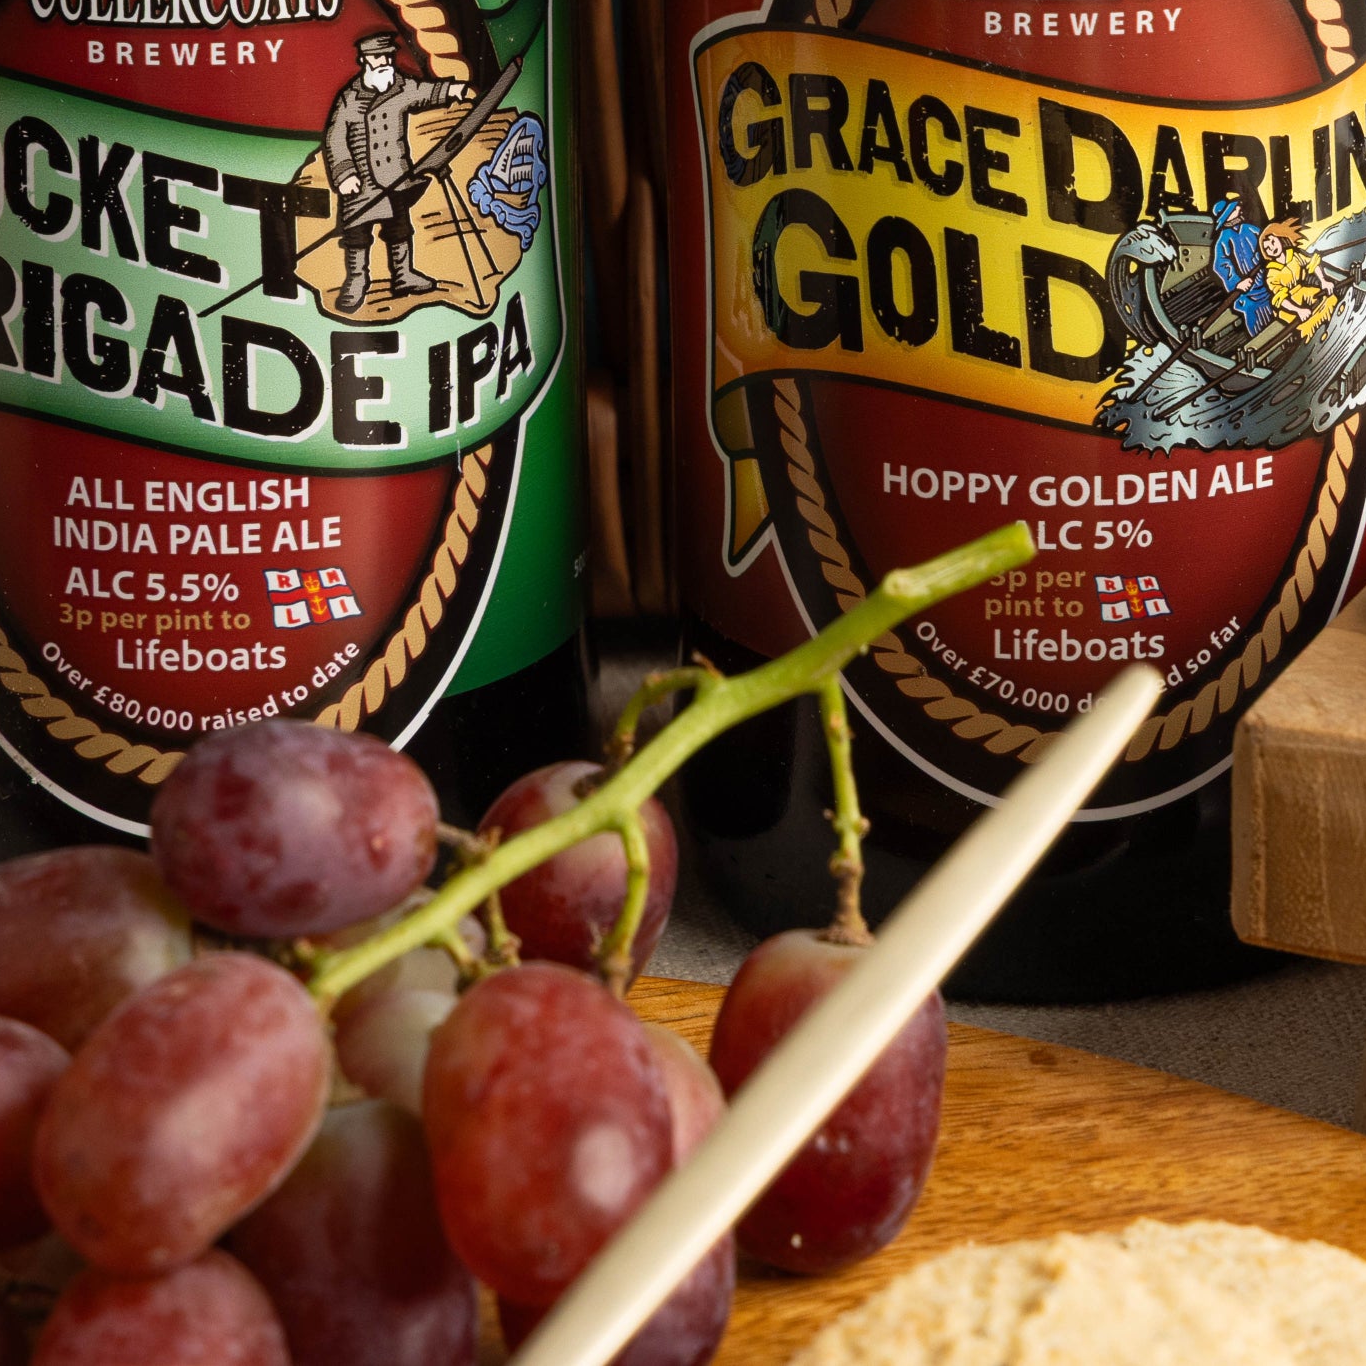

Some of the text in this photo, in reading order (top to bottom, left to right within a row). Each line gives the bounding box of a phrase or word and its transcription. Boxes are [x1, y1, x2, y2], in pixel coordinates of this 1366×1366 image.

[984, 7, 1183, 37] BREWERY
[87, 38, 286, 65] BREWERY
[718, 61, 1029, 216] GRACE
[753, 189, 1133, 384] GOLD
[427, 290, 535, 435] IPA
[66, 476, 311, 512] ALL ENGLISH
[882, 456, 1275, 507] HOPPY GOLDEN ALE
[53, 516, 342, 555] INDIA PALE ALE
[1015, 519, 1153, 550] LC 5%
[64, 567, 239, 602] ALC 5.5%
[1036, 570, 1086, 593] per
[59, 603, 251, 635] 3p per pint to
[985, 594, 1084, 620] pint to
[117, 638, 287, 671] Lifeboats
[994, 629, 1165, 661] Lifeboats
[916, 621, 968, 672] Over
[967, 665, 1070, 713] £70,000
[1185, 648, 1211, 674] so
[1210, 615, 1241, 650] far
[42, 642, 360, 731] Over £80,000 raised to date
